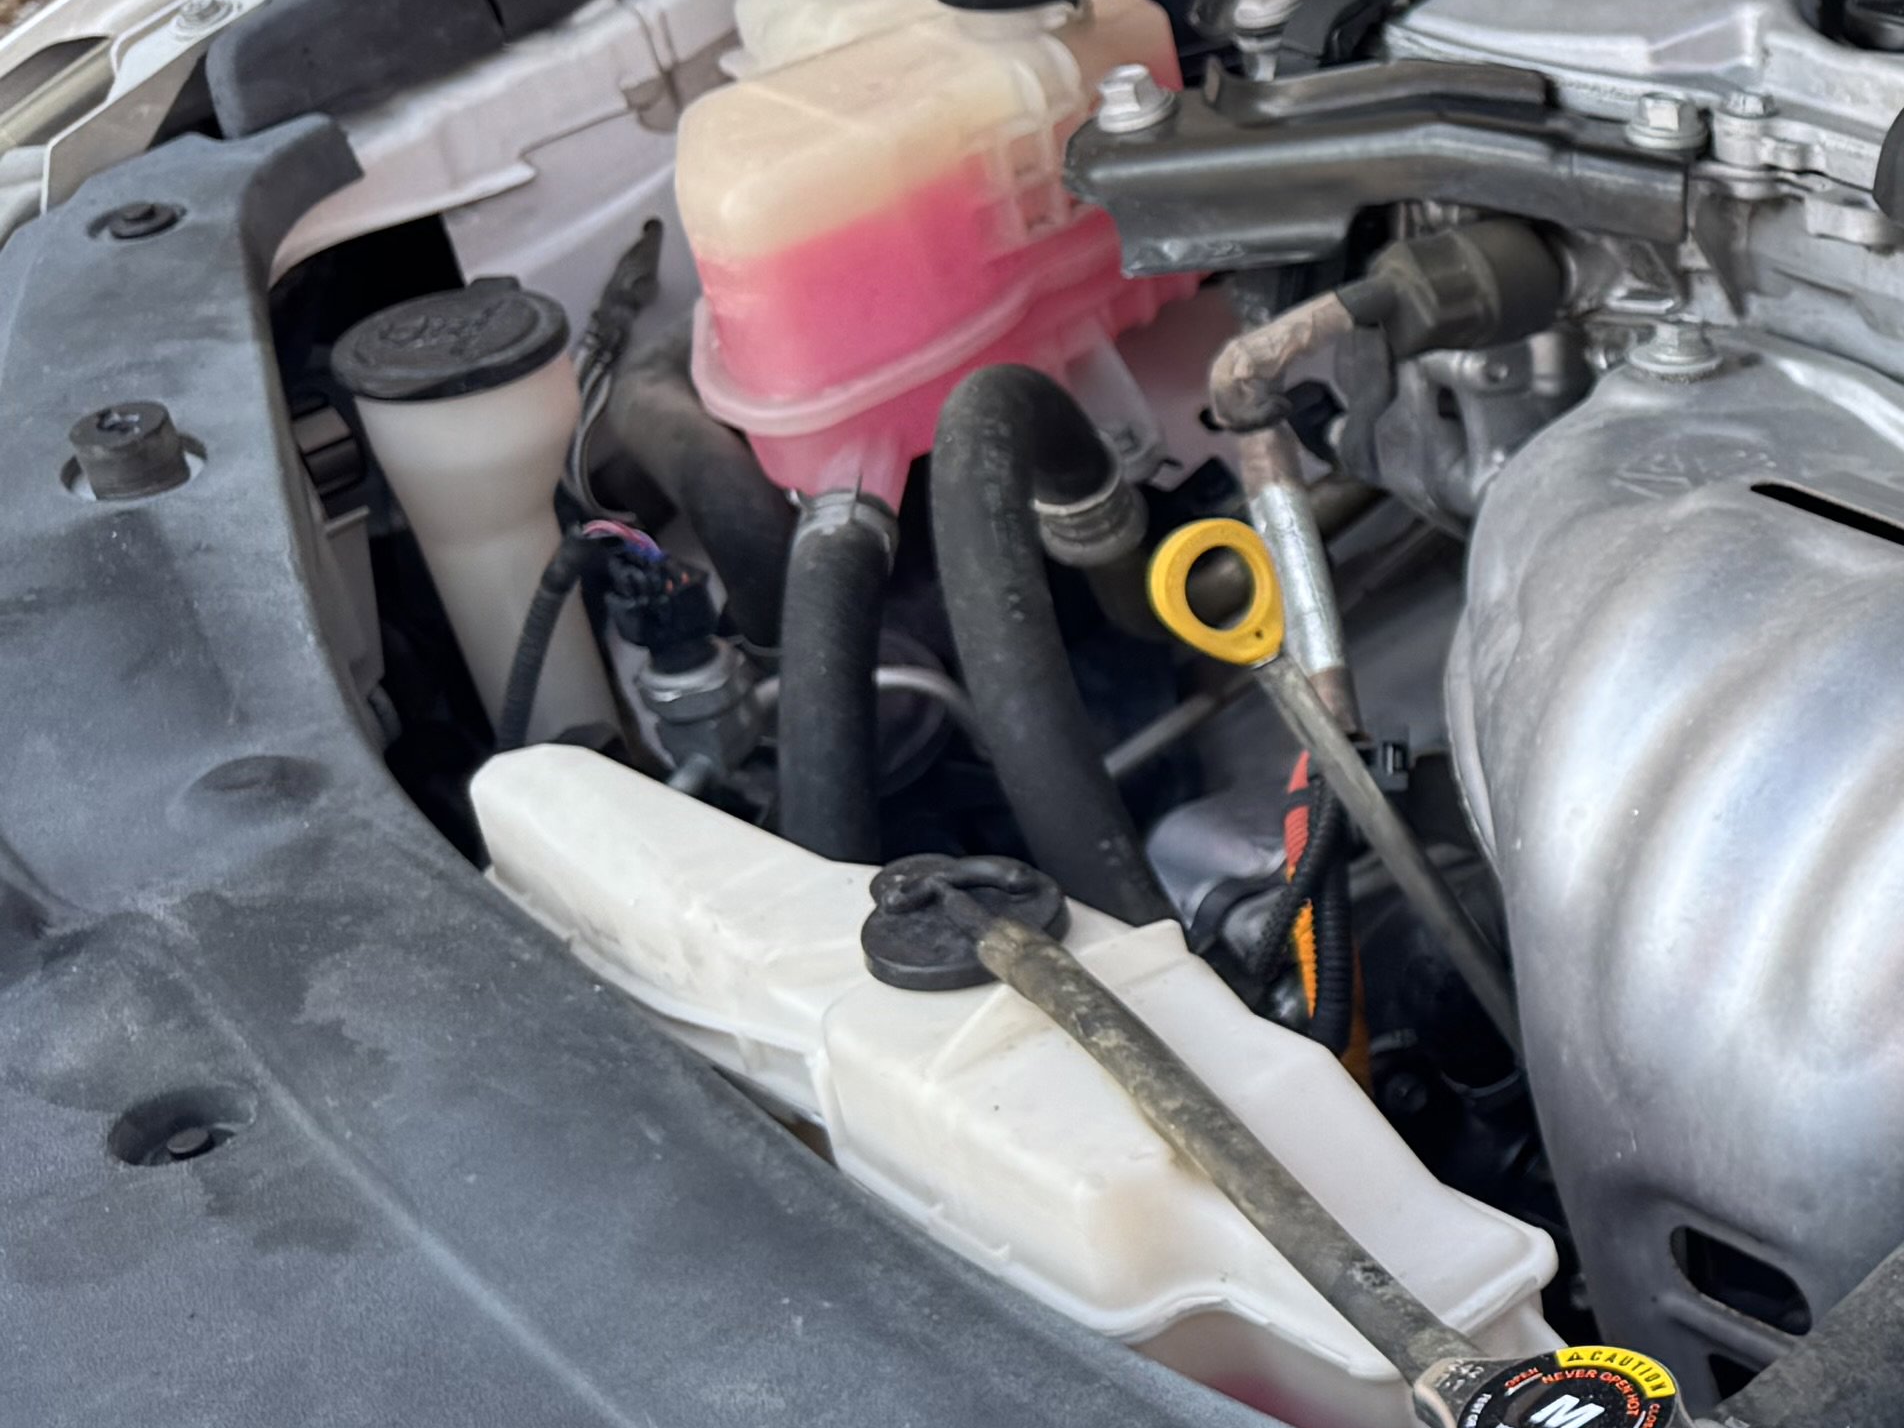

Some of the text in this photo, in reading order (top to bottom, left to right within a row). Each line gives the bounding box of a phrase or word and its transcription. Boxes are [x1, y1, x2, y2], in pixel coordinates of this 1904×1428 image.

[1504, 1367, 1540, 1390] OPEN
[1589, 1351, 1669, 1392] CAUTION
[1541, 1369, 1643, 1417] NEVER OPEN HOT
